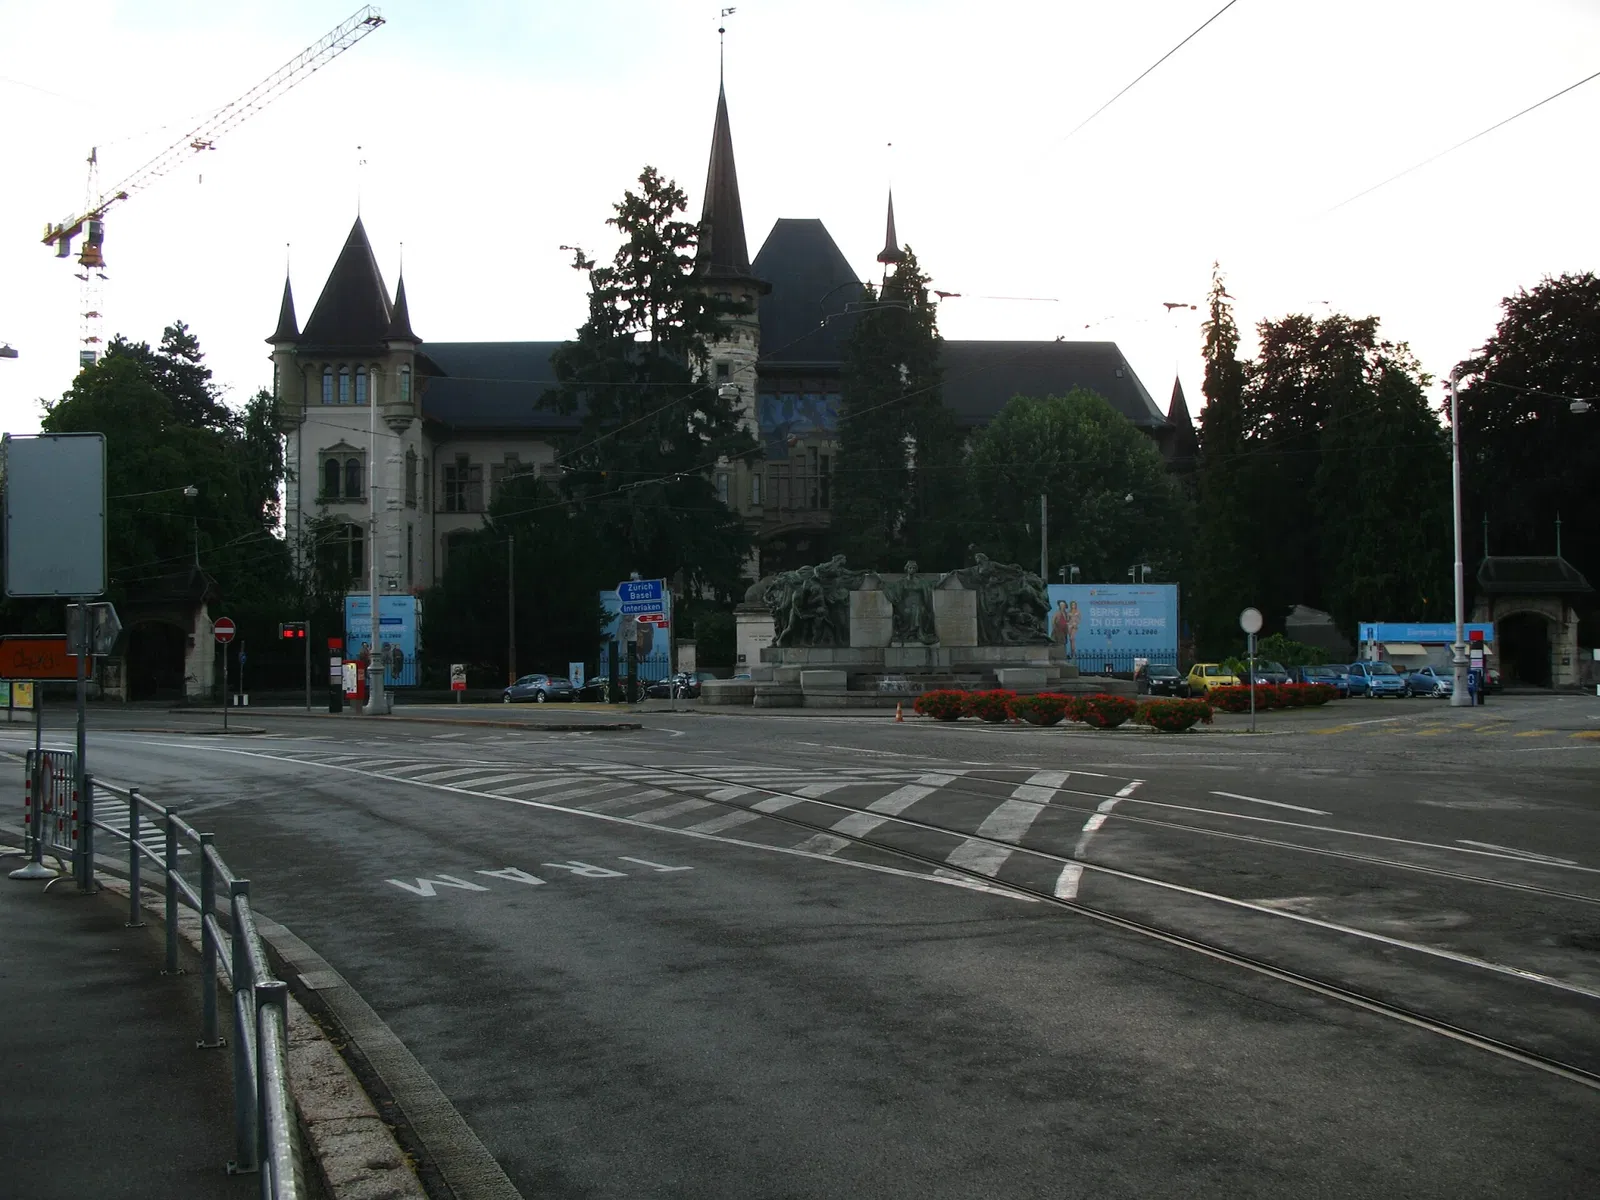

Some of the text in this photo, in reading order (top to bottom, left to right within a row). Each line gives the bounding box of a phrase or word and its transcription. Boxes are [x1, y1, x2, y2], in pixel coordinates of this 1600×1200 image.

[627, 582, 653, 592] Zürich
[630, 591, 653, 600] Basel
[623, 603, 661, 613] Interlaken
[1125, 618, 1167, 627] MODERNE
